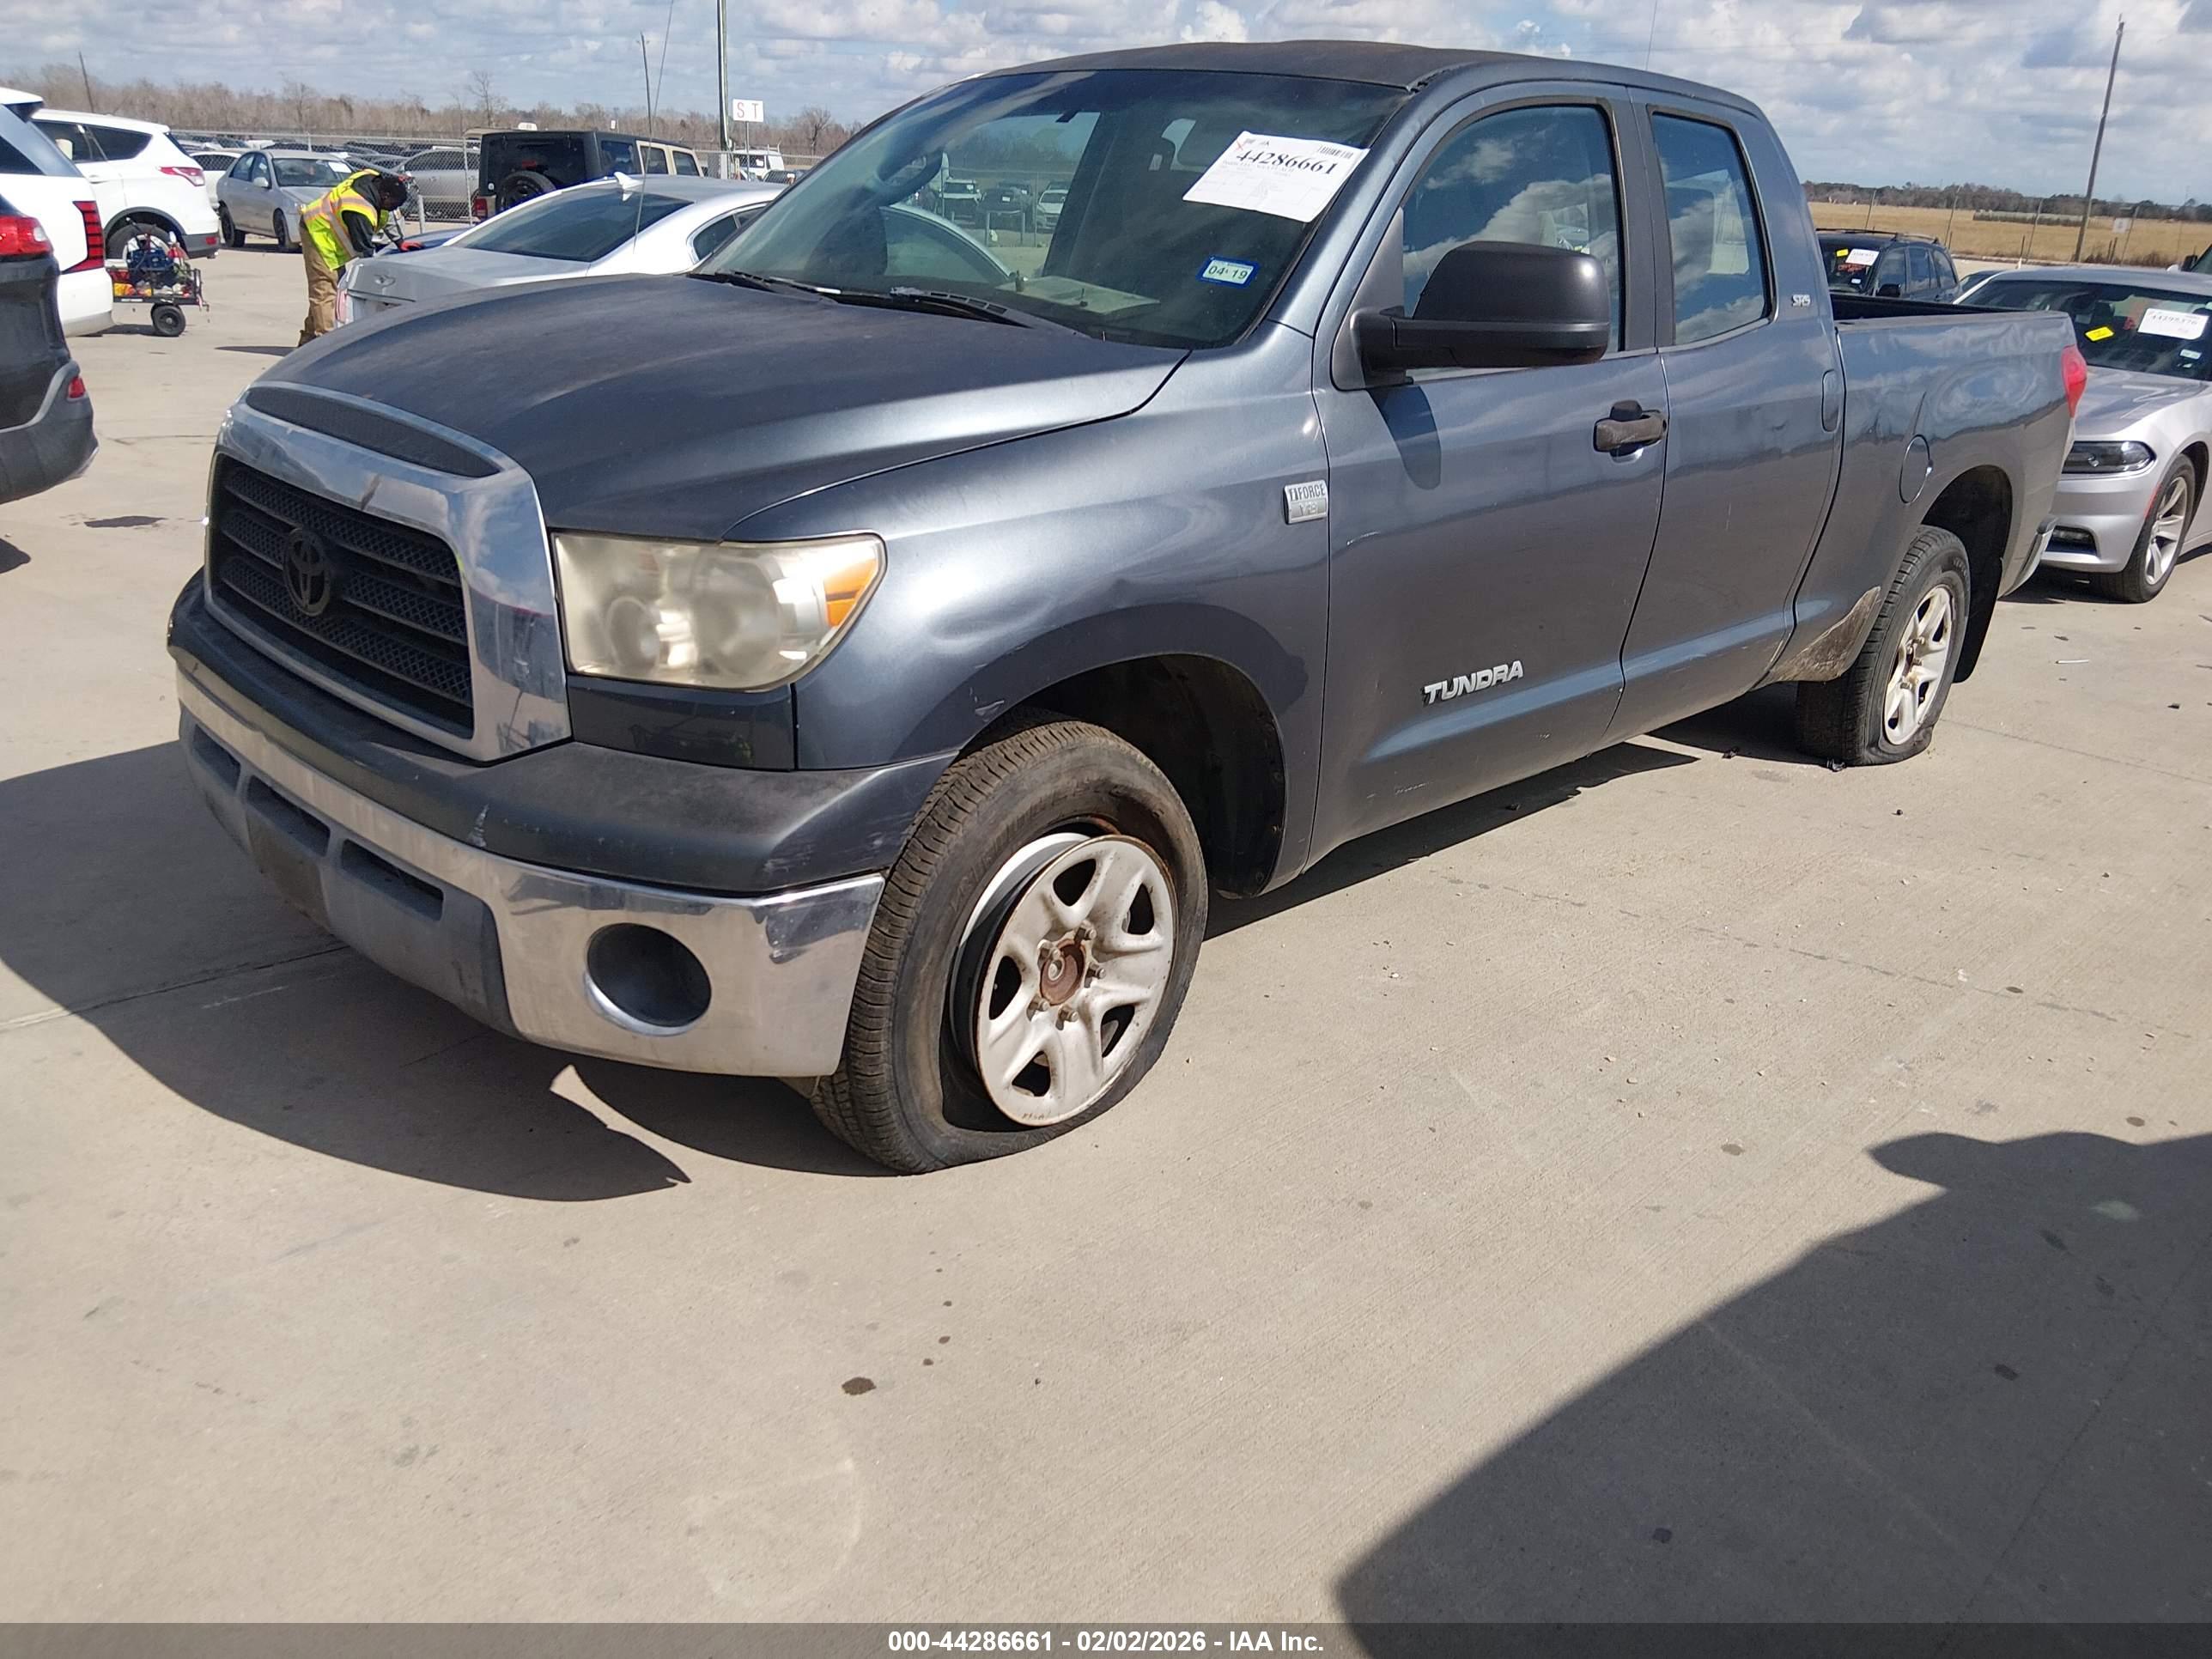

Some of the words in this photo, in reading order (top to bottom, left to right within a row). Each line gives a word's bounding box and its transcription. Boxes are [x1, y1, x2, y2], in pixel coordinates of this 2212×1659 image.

[1236, 149, 1339, 175] 44286661
[1208, 264, 1225, 276] 04
[1231, 268, 1249, 280] 19
[1424, 659, 1524, 704] TUNDRA
